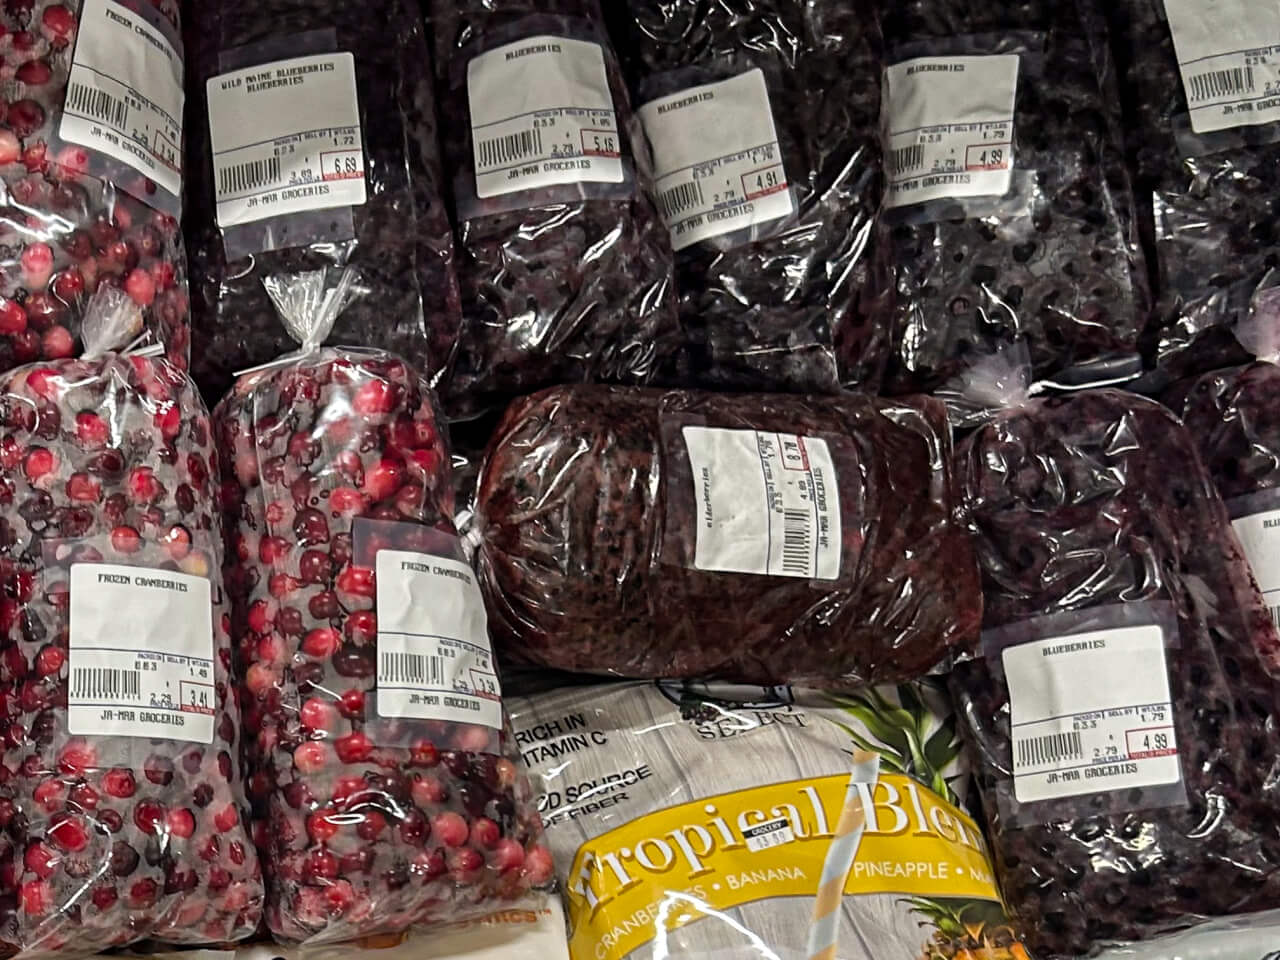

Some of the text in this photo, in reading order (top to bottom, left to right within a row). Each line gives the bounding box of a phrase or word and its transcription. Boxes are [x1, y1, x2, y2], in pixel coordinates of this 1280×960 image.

[505, 44, 561, 61] BLUEBERRIES
[221, 78, 241, 90] WILD
[276, 63, 334, 77] BLUEBERRIES
[246, 76, 303, 93] BLUEBERRIES
[657, 91, 714, 114] BLUEBERRIES
[507, 159, 591, 179] JA-MAR GROCERIES
[921, 175, 970, 187] GROCERIES
[247, 185, 330, 207] JA-MAR GROCERIES
[707, 204, 754, 224] GROCERIES
[815, 467, 827, 513] GROCERIES
[401, 562, 429, 572] FROZEN
[97, 574, 188, 592] FROZEN CRANBERRIES
[1041, 640, 1105, 657] BLUEBERRIES
[409, 694, 480, 711] JA-MAR GROCERIES
[100, 710, 184, 725] JA-MAR GROCERIES
[514, 712, 586, 747] RICH IN
[521, 731, 606, 767] ITAMIN C
[1142, 733, 1168, 749] 4.99
[1045, 763, 1136, 784] JA-MAR GROCERIES
[565, 765, 652, 803] SOURCE
[567, 792, 629, 819] FIBER
[853, 781, 985, 855] Blen
[726, 867, 804, 891] BANANA
[854, 861, 947, 879] PINEAPPLE
